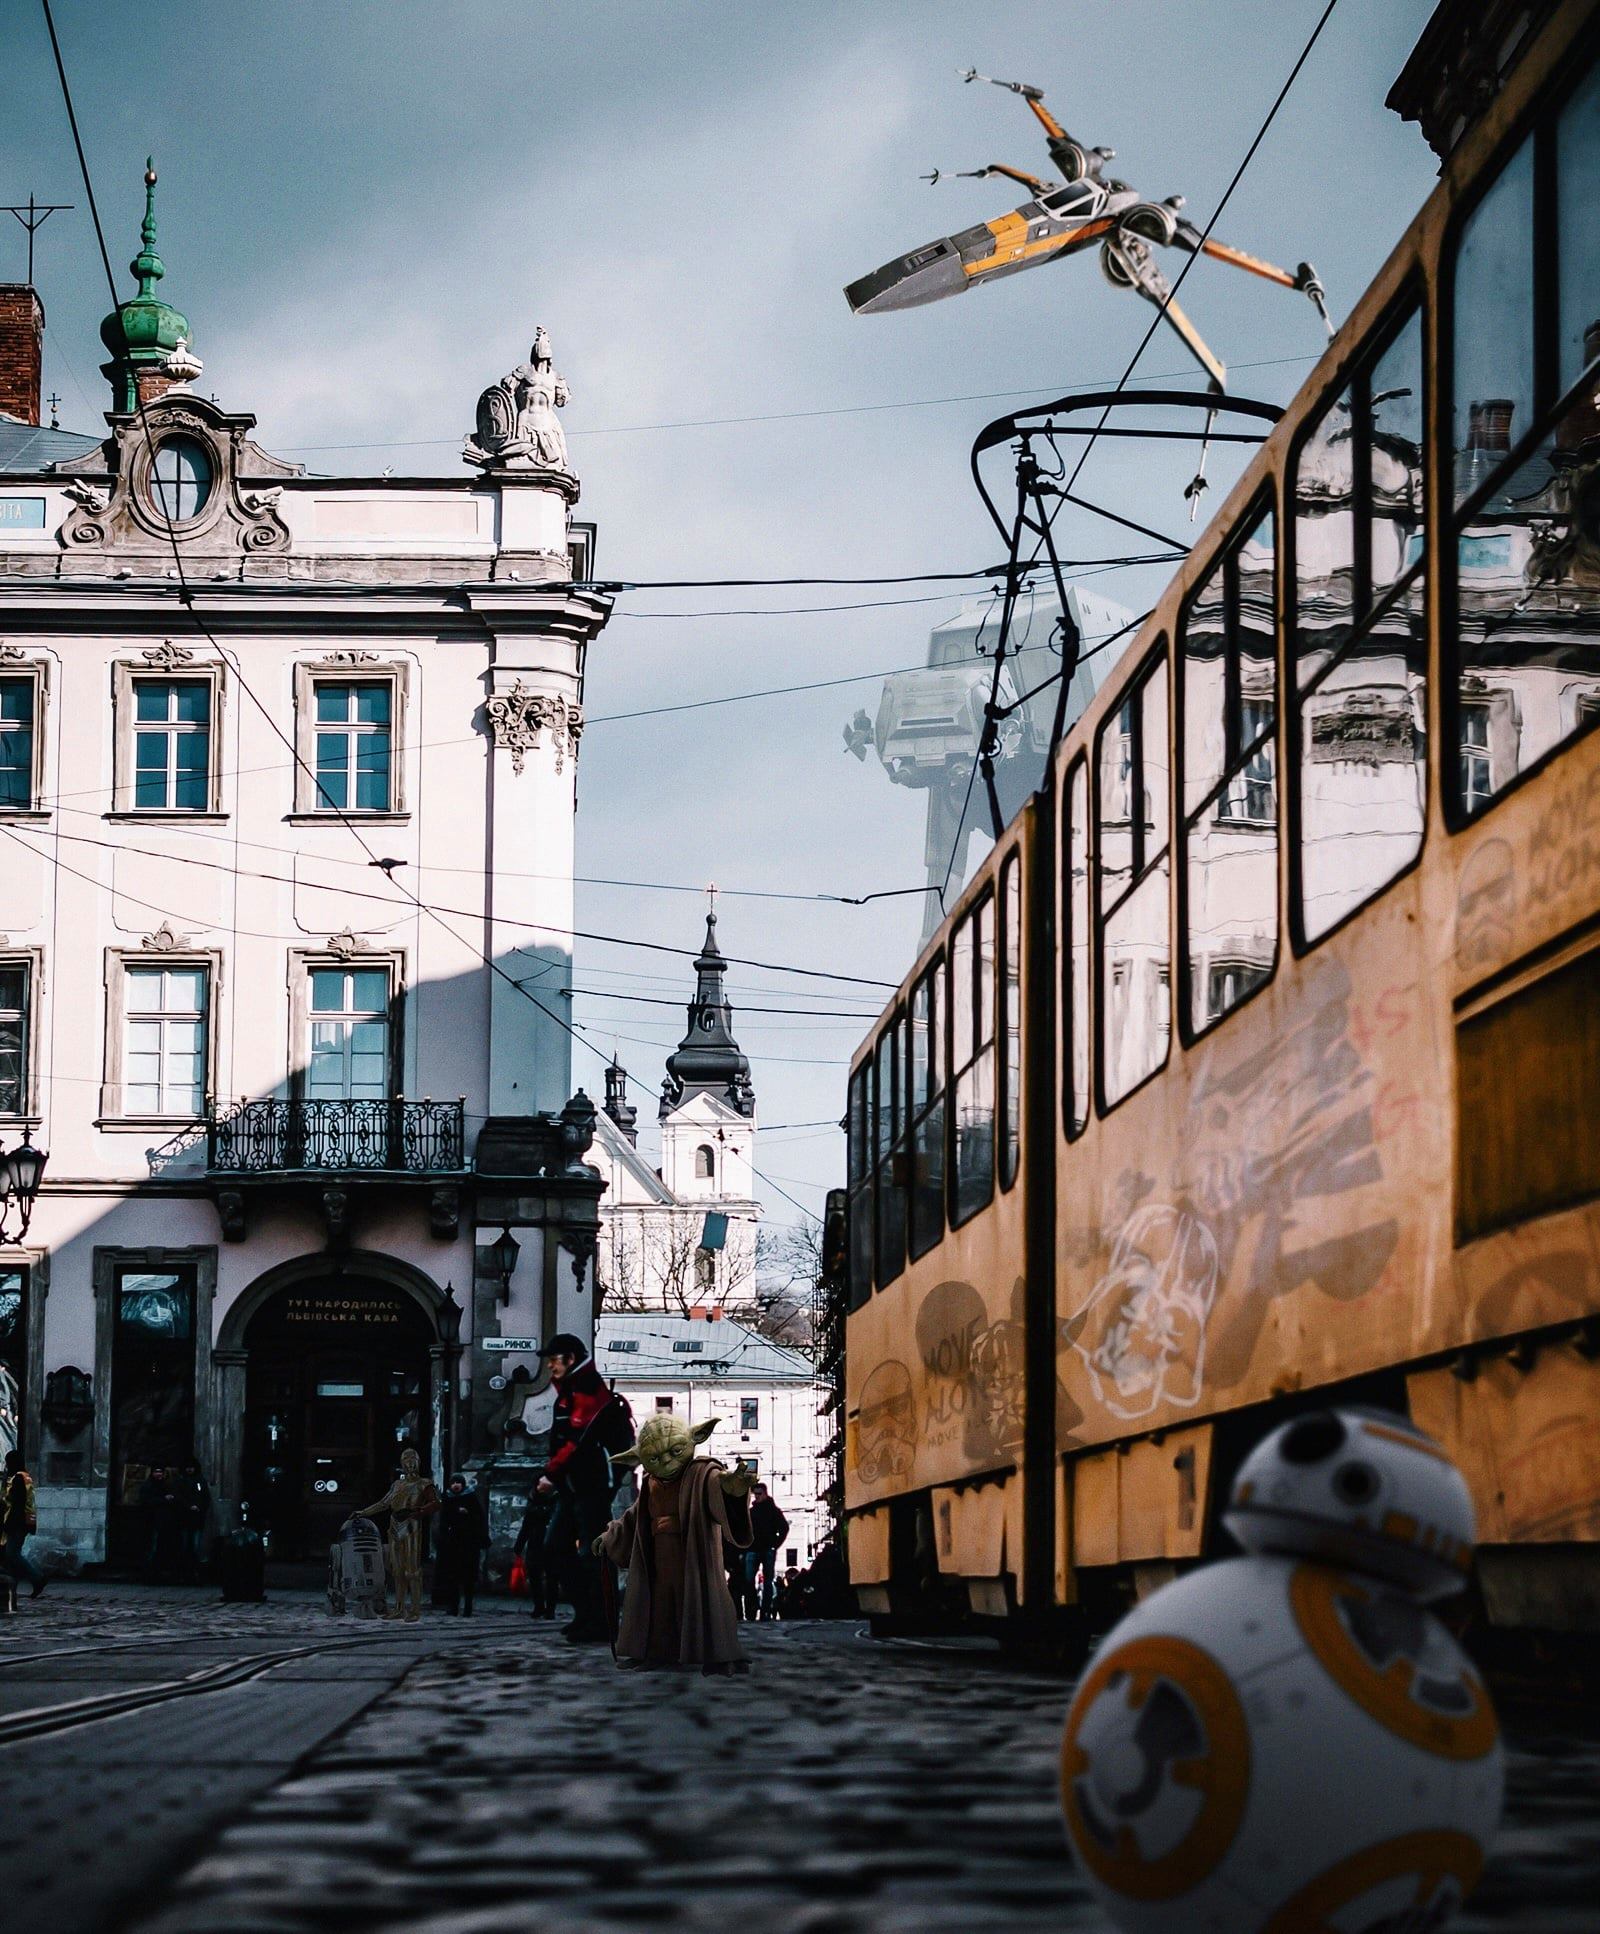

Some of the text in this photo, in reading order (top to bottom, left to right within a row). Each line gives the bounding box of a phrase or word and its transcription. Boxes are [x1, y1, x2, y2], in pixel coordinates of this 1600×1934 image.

[287, 1299, 401, 1309] ТУТ НАРОДИЛАСЬ
[286, 1312, 399, 1322] ЛЬВІВСЬКА КАВА
[505, 1340, 532, 1349] РИНОК
